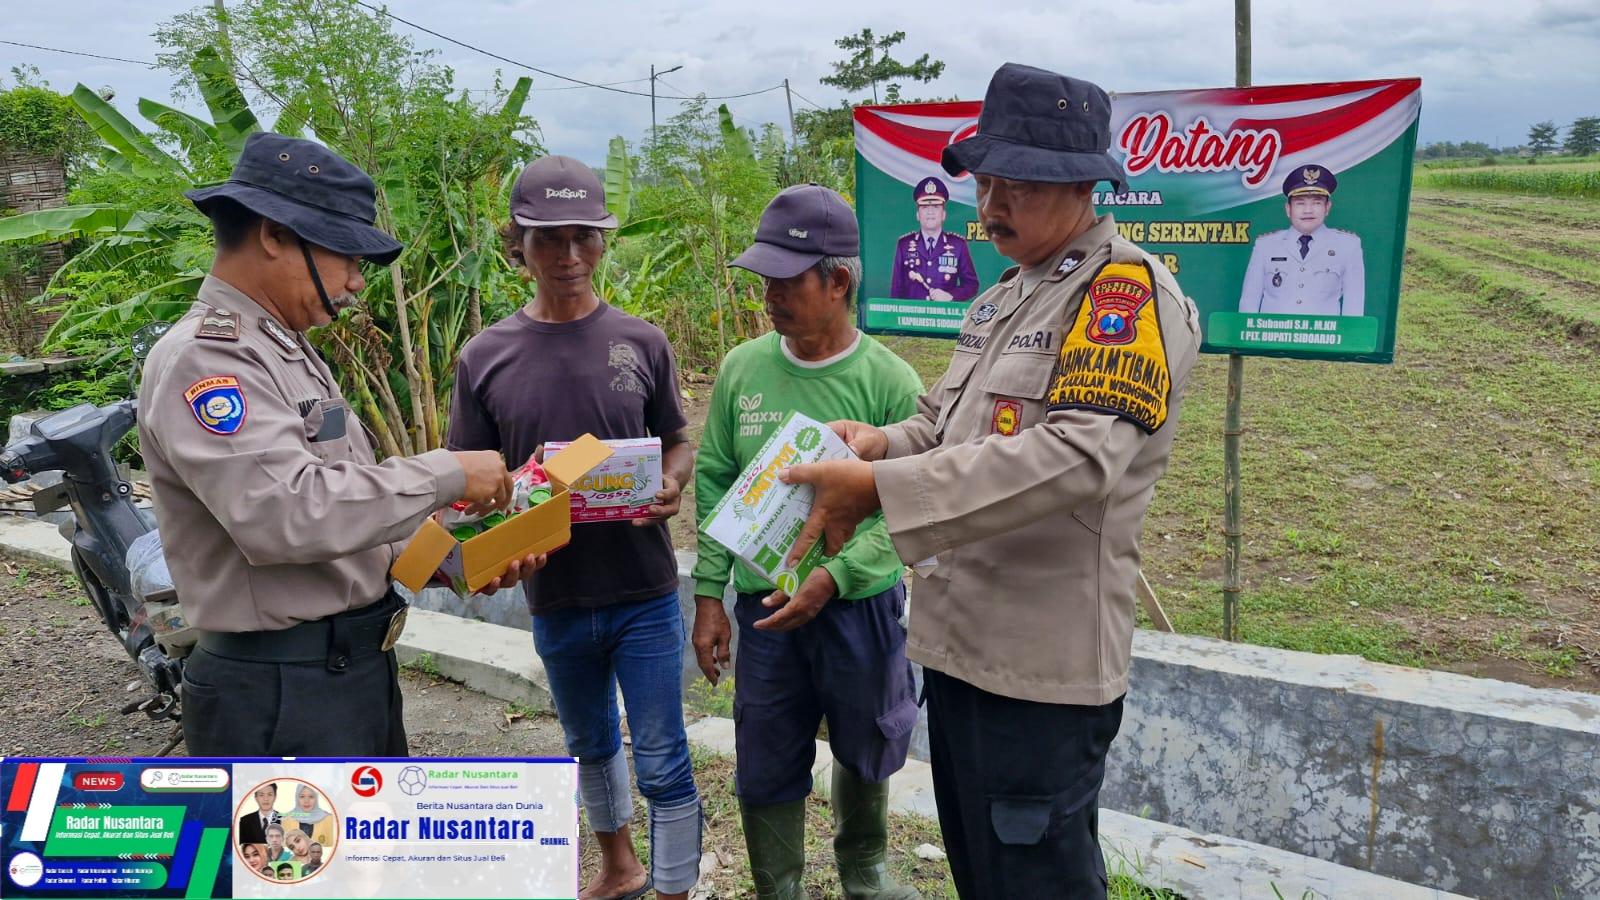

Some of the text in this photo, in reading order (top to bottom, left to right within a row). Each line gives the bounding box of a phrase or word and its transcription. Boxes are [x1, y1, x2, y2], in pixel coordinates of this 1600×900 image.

[1121, 114, 1277, 185] Datang
[1103, 191, 1162, 205] ACARA
[1148, 223, 1249, 243] SERENTAK
[1009, 331, 1052, 349] POLRI
[1262, 332, 1292, 343] BUPATI
[1293, 333, 1336, 345] SIDOARJO
[1060, 389, 1157, 425] BALONGBENDO
[573, 472, 634, 491] GUNG
[588, 491, 631, 500] JOSSS
[752, 502, 787, 546] PETUNJUK
